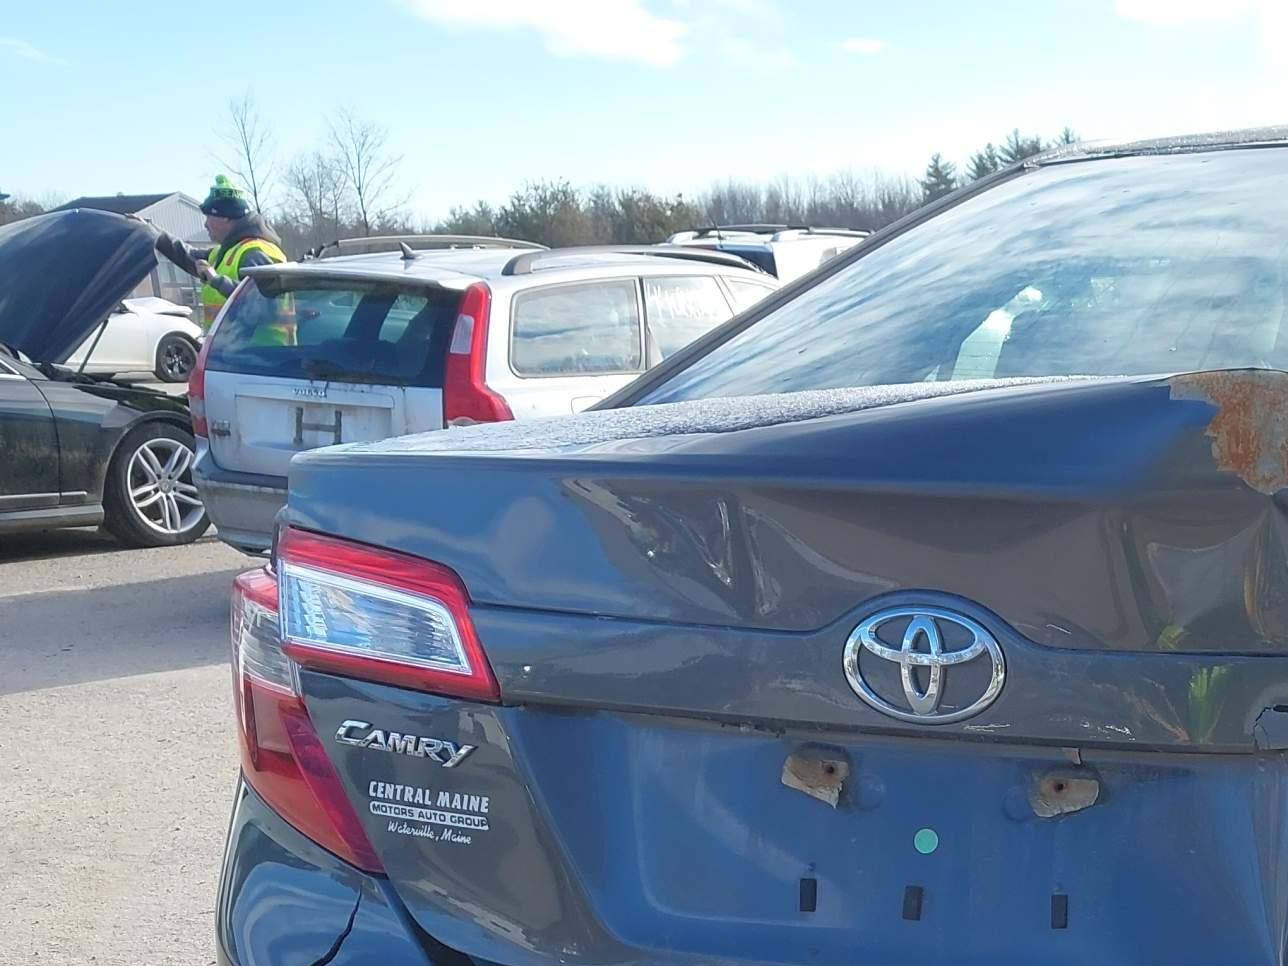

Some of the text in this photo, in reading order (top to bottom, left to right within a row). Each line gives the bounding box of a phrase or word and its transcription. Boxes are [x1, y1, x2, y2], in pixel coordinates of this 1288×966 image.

[335, 719, 478, 768] CAMRY
[369, 781, 489, 812] CENTRAL MAINE
[372, 804, 488, 829] MOTORS AUTO GROUP
[440, 827, 473, 845] Maine
